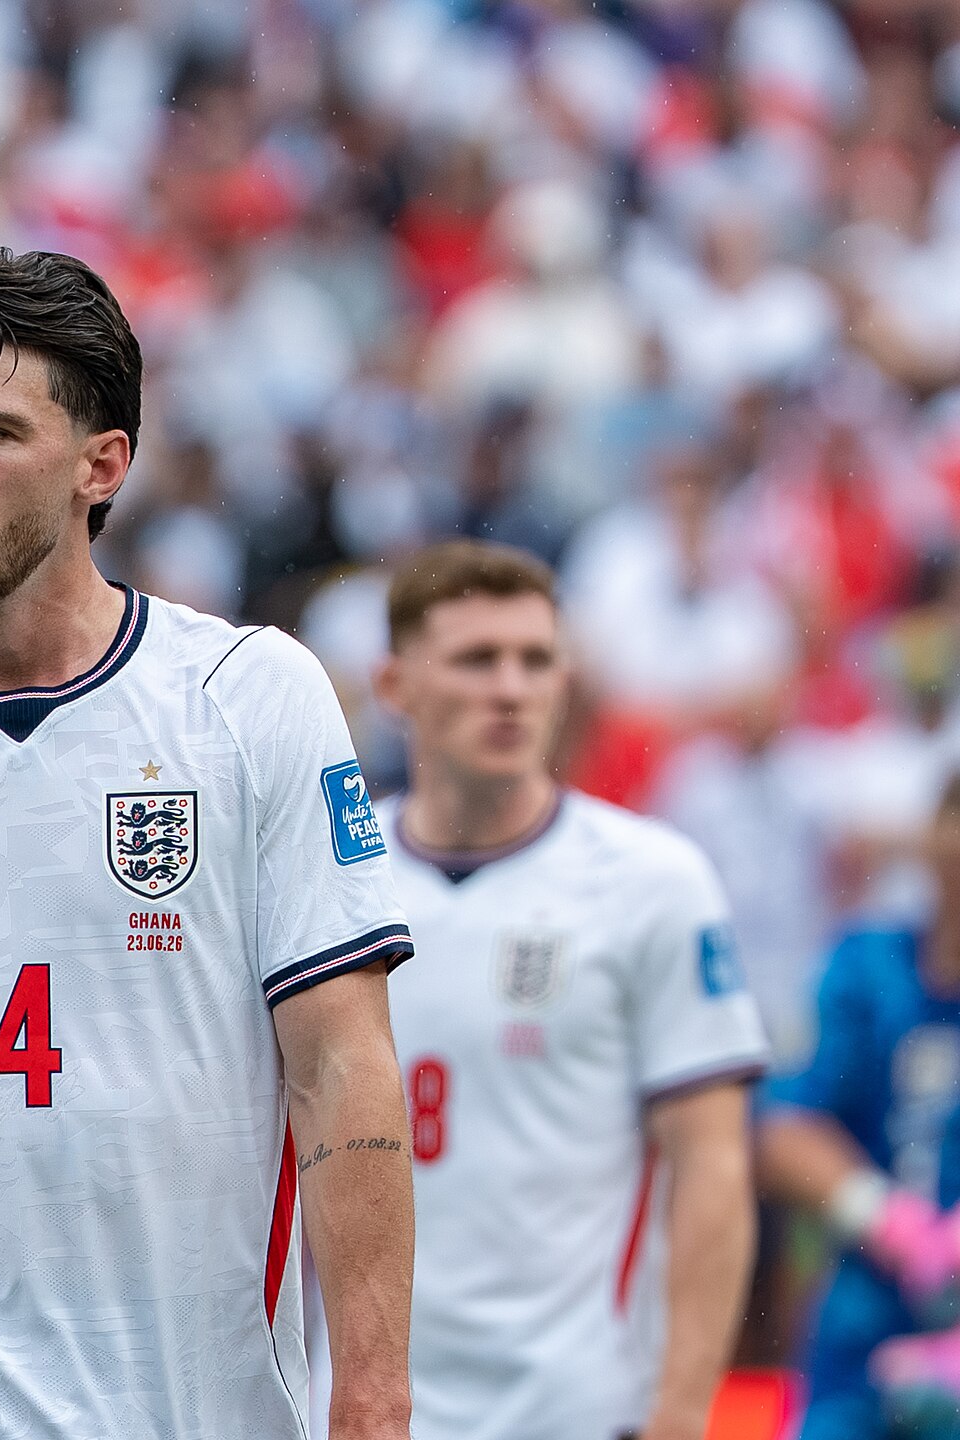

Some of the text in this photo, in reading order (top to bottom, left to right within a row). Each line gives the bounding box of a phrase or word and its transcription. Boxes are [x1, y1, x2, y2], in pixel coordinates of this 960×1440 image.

[348, 818, 380, 840] PEAC
[361, 835, 383, 849] FIFA
[129, 912, 181, 929] GHANA
[127, 934, 183, 951] 23.06.26
[410, 1056, 447, 1163] 8
